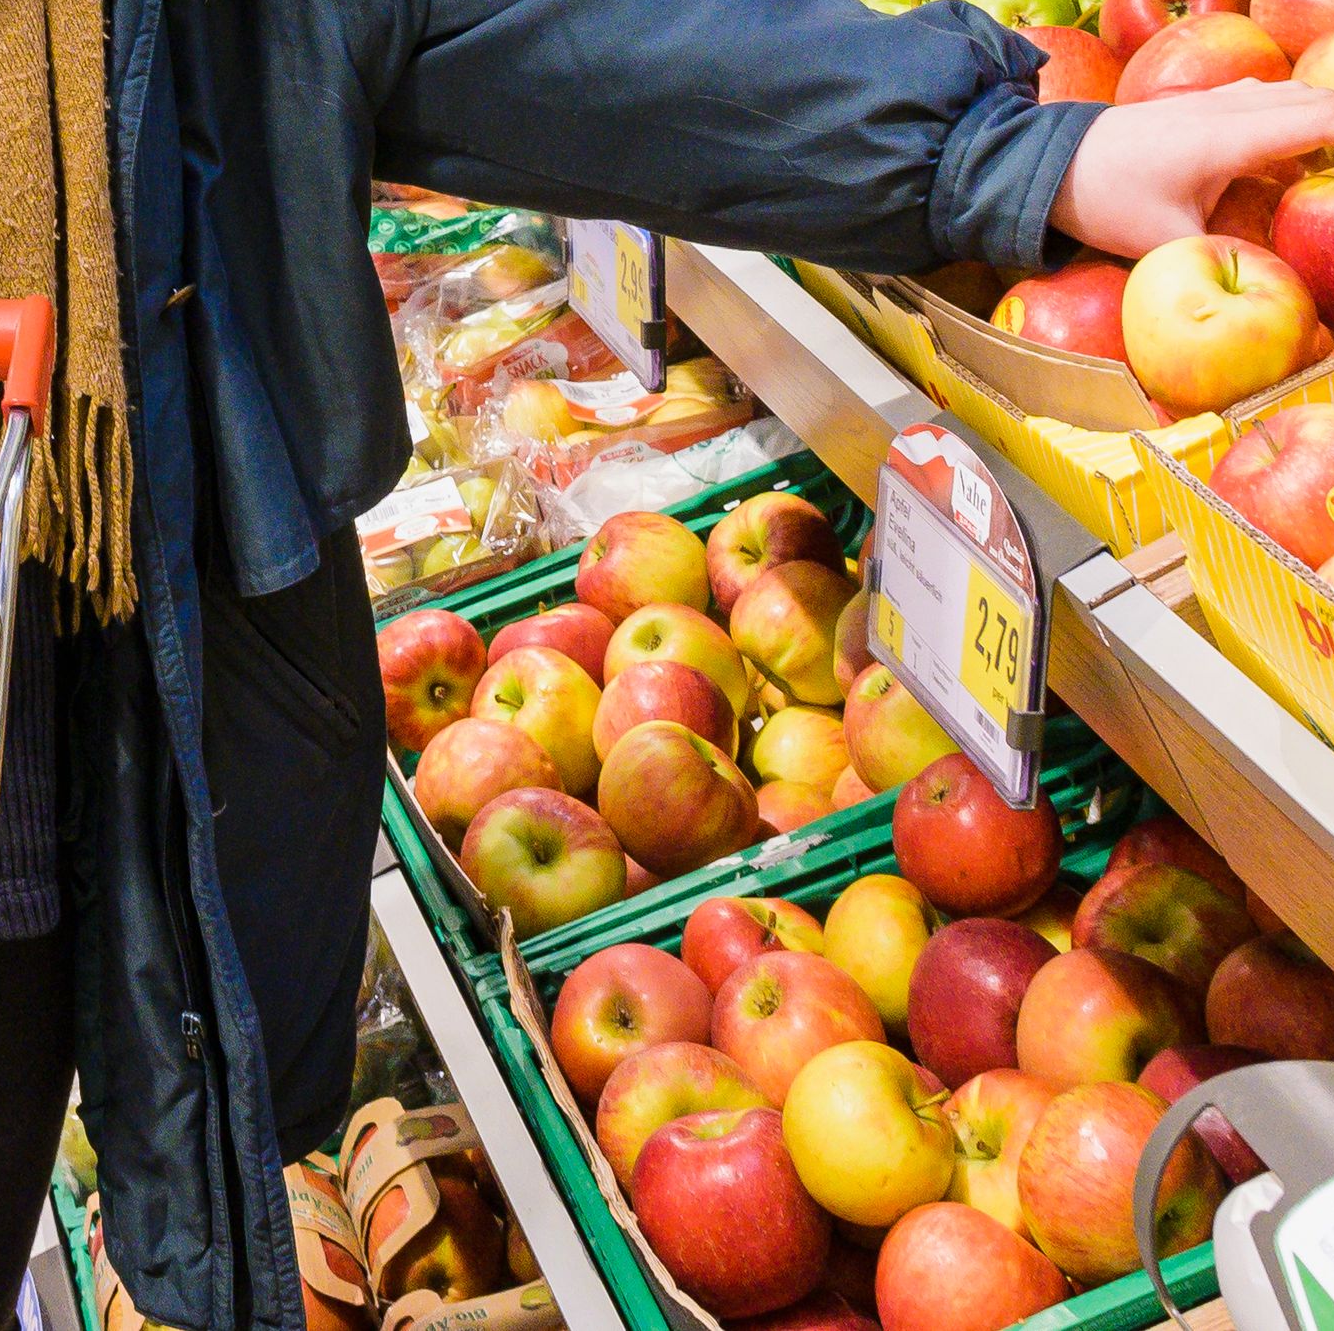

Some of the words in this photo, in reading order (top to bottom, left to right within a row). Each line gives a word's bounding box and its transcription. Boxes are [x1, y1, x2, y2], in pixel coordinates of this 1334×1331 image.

[508, 352, 548, 380] SNACK
[888, 514, 916, 554] Evelina
[974, 596, 1019, 685] 2,79
